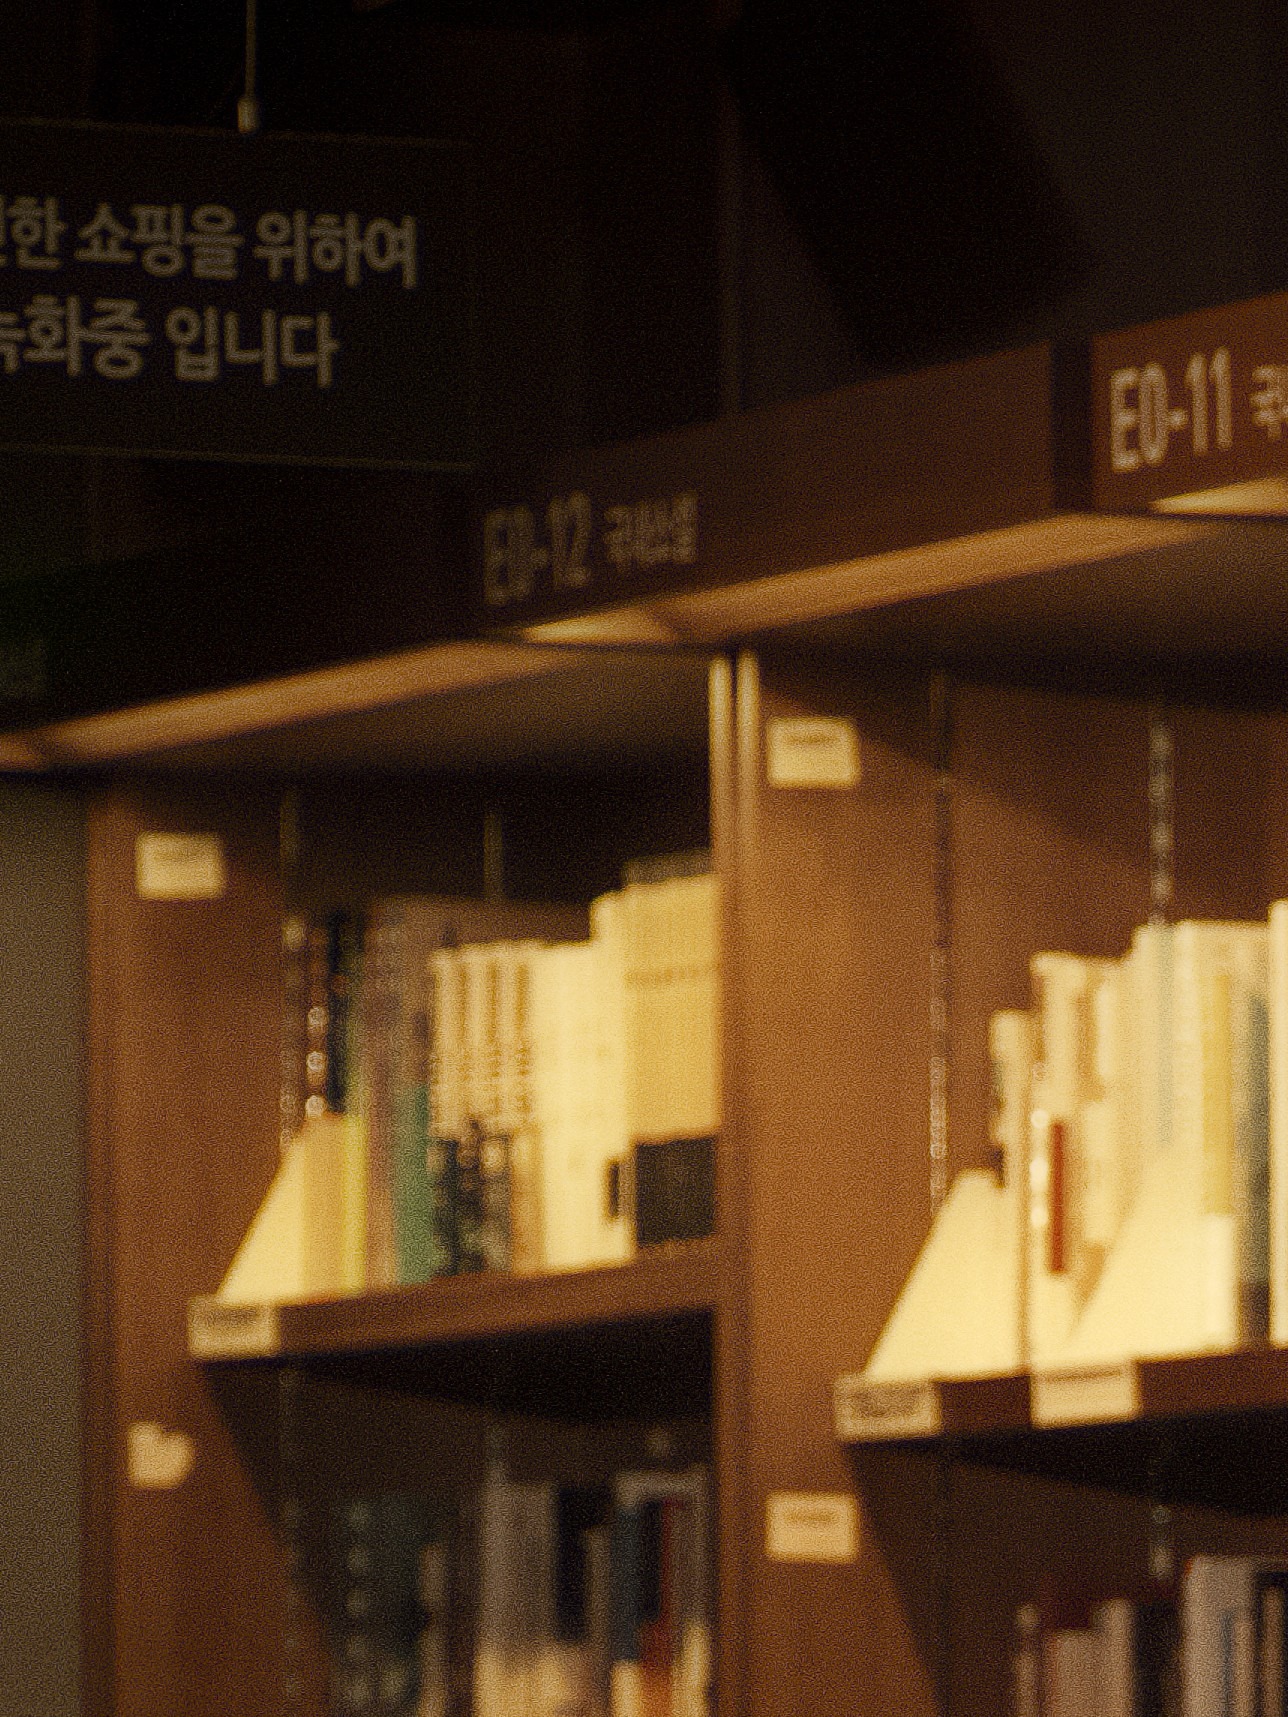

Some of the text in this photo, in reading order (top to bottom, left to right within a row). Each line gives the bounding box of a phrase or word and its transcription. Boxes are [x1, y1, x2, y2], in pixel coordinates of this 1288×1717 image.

[0, 196, 418, 290] 한 쇼핑을 위하여
[164, 306, 341, 389] 입니다
